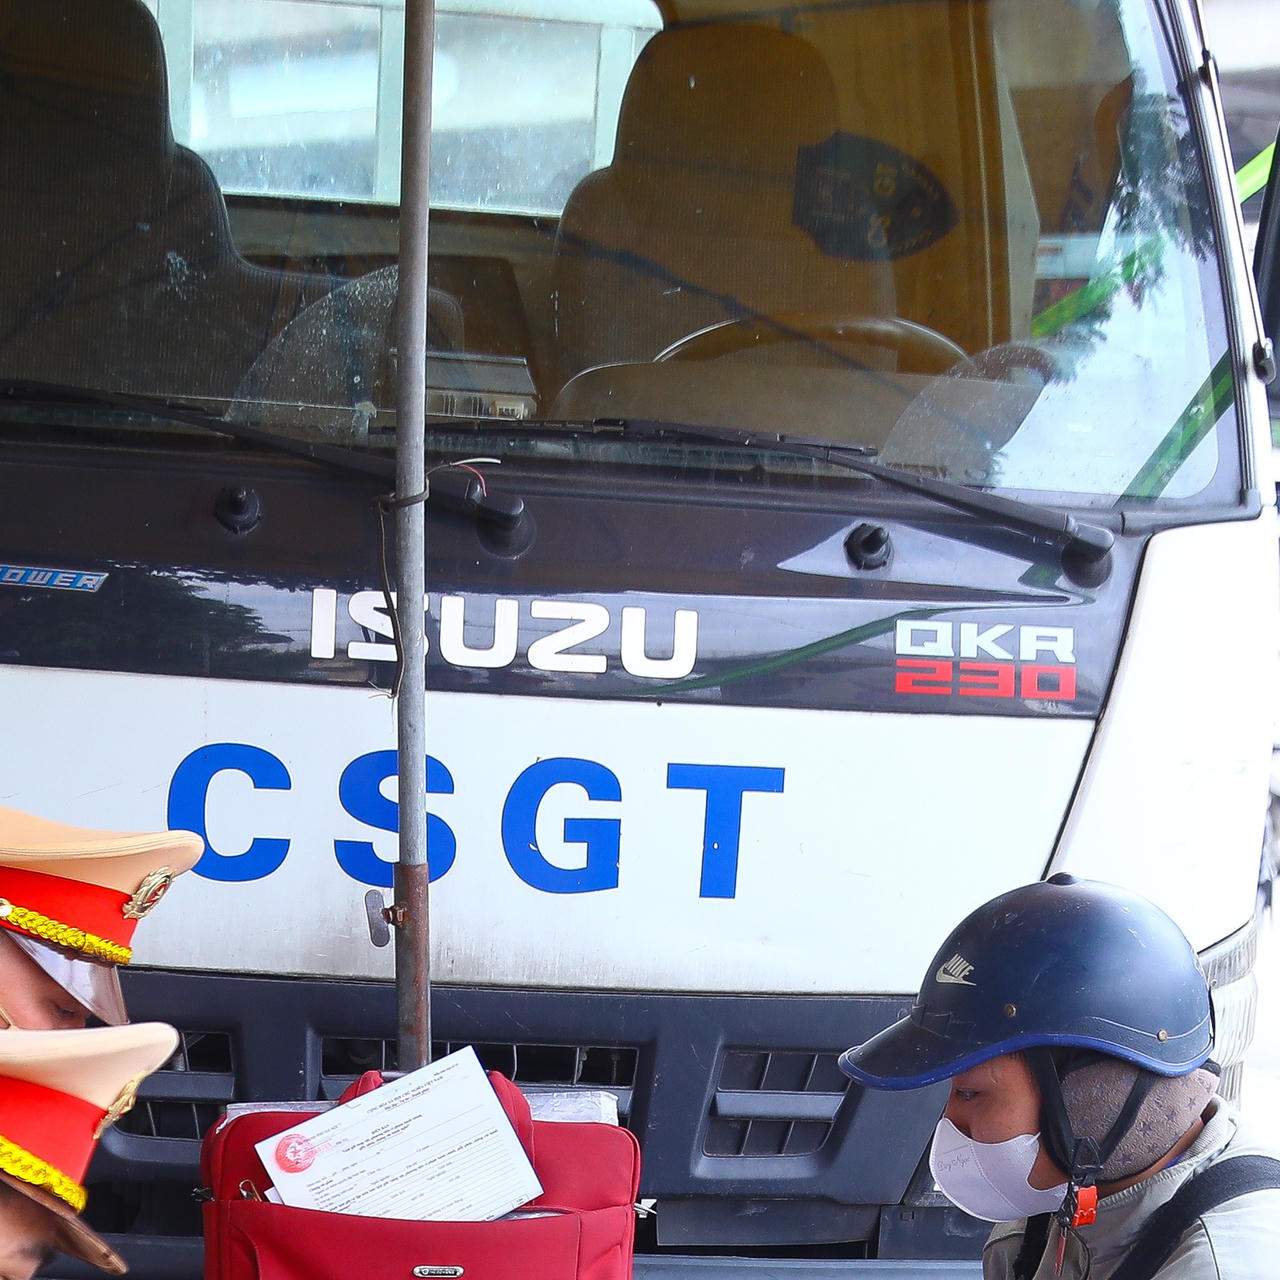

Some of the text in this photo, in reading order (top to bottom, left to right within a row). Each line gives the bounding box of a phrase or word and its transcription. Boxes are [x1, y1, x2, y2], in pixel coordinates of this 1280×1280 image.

[310, 587, 699, 680] ISUZU
[894, 619, 1077, 663] QKR
[894, 658, 1077, 700] 230
[167, 742, 786, 899] CSGT
